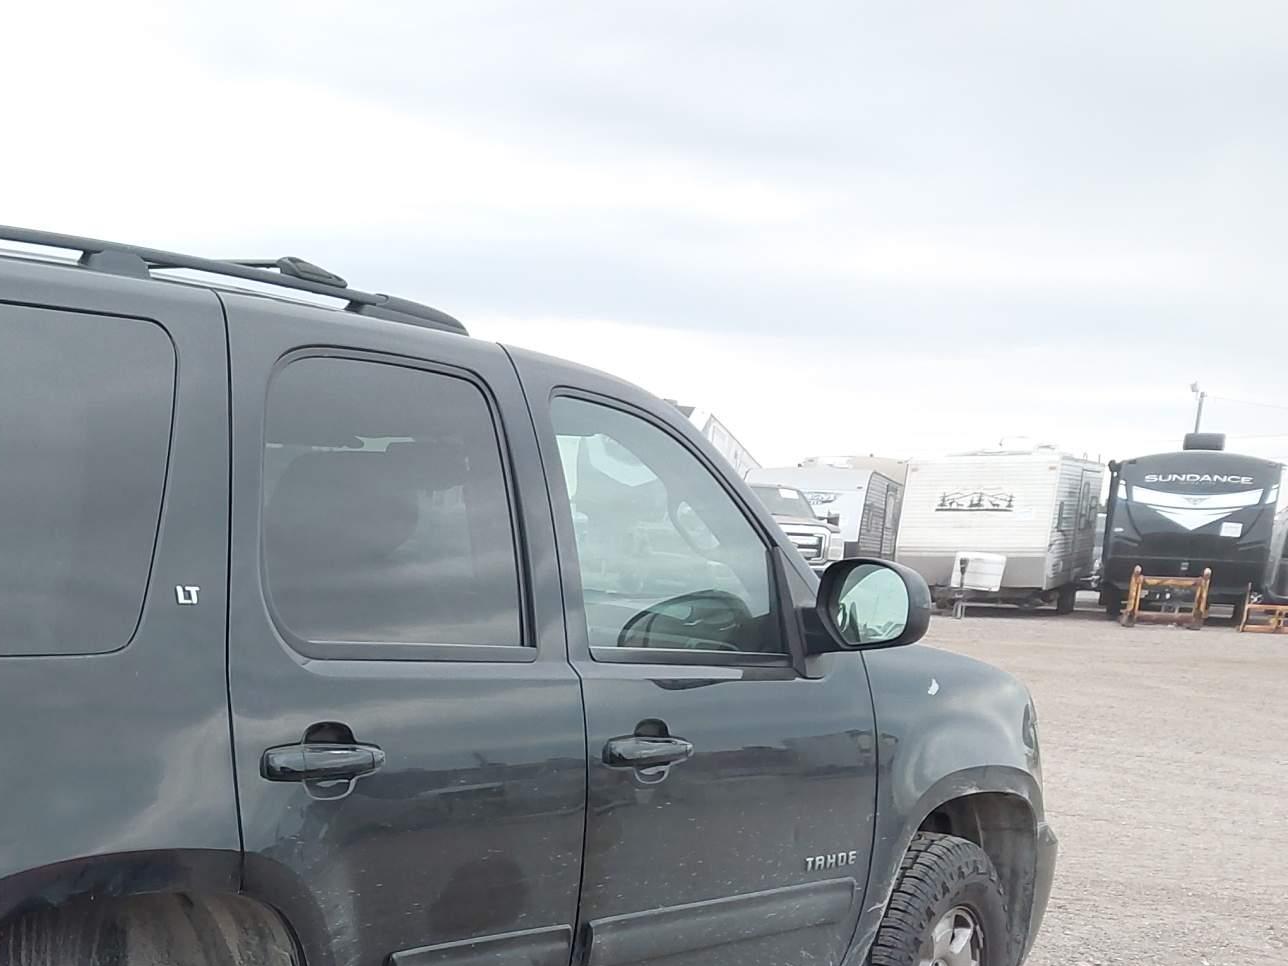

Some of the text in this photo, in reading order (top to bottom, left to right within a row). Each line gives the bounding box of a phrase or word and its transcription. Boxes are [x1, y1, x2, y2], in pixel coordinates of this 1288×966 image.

[1144, 474, 1255, 485] SUNDANCE
[175, 585, 200, 604] LT
[805, 850, 857, 872] TAHOE
